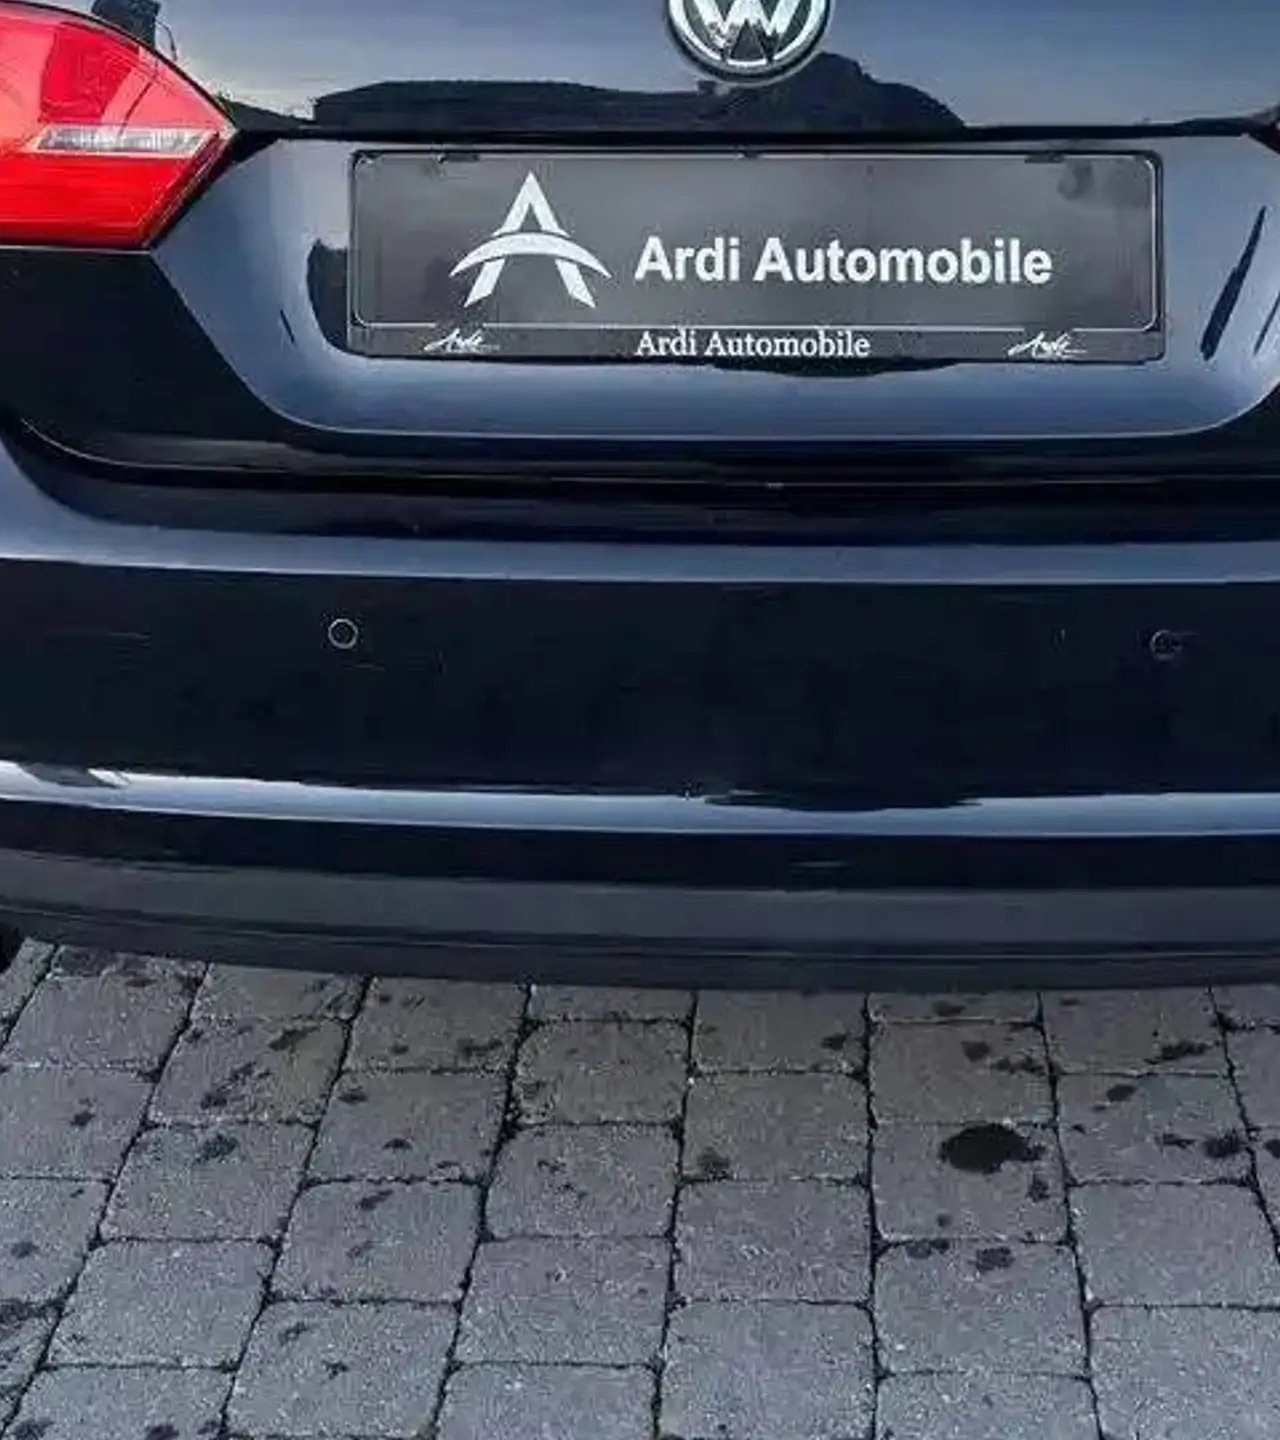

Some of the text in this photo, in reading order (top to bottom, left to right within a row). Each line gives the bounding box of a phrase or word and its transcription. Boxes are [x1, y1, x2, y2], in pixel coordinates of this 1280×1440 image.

[634, 236, 1053, 284] Ardi Automobile
[635, 328, 871, 358] Ardi Automobile
